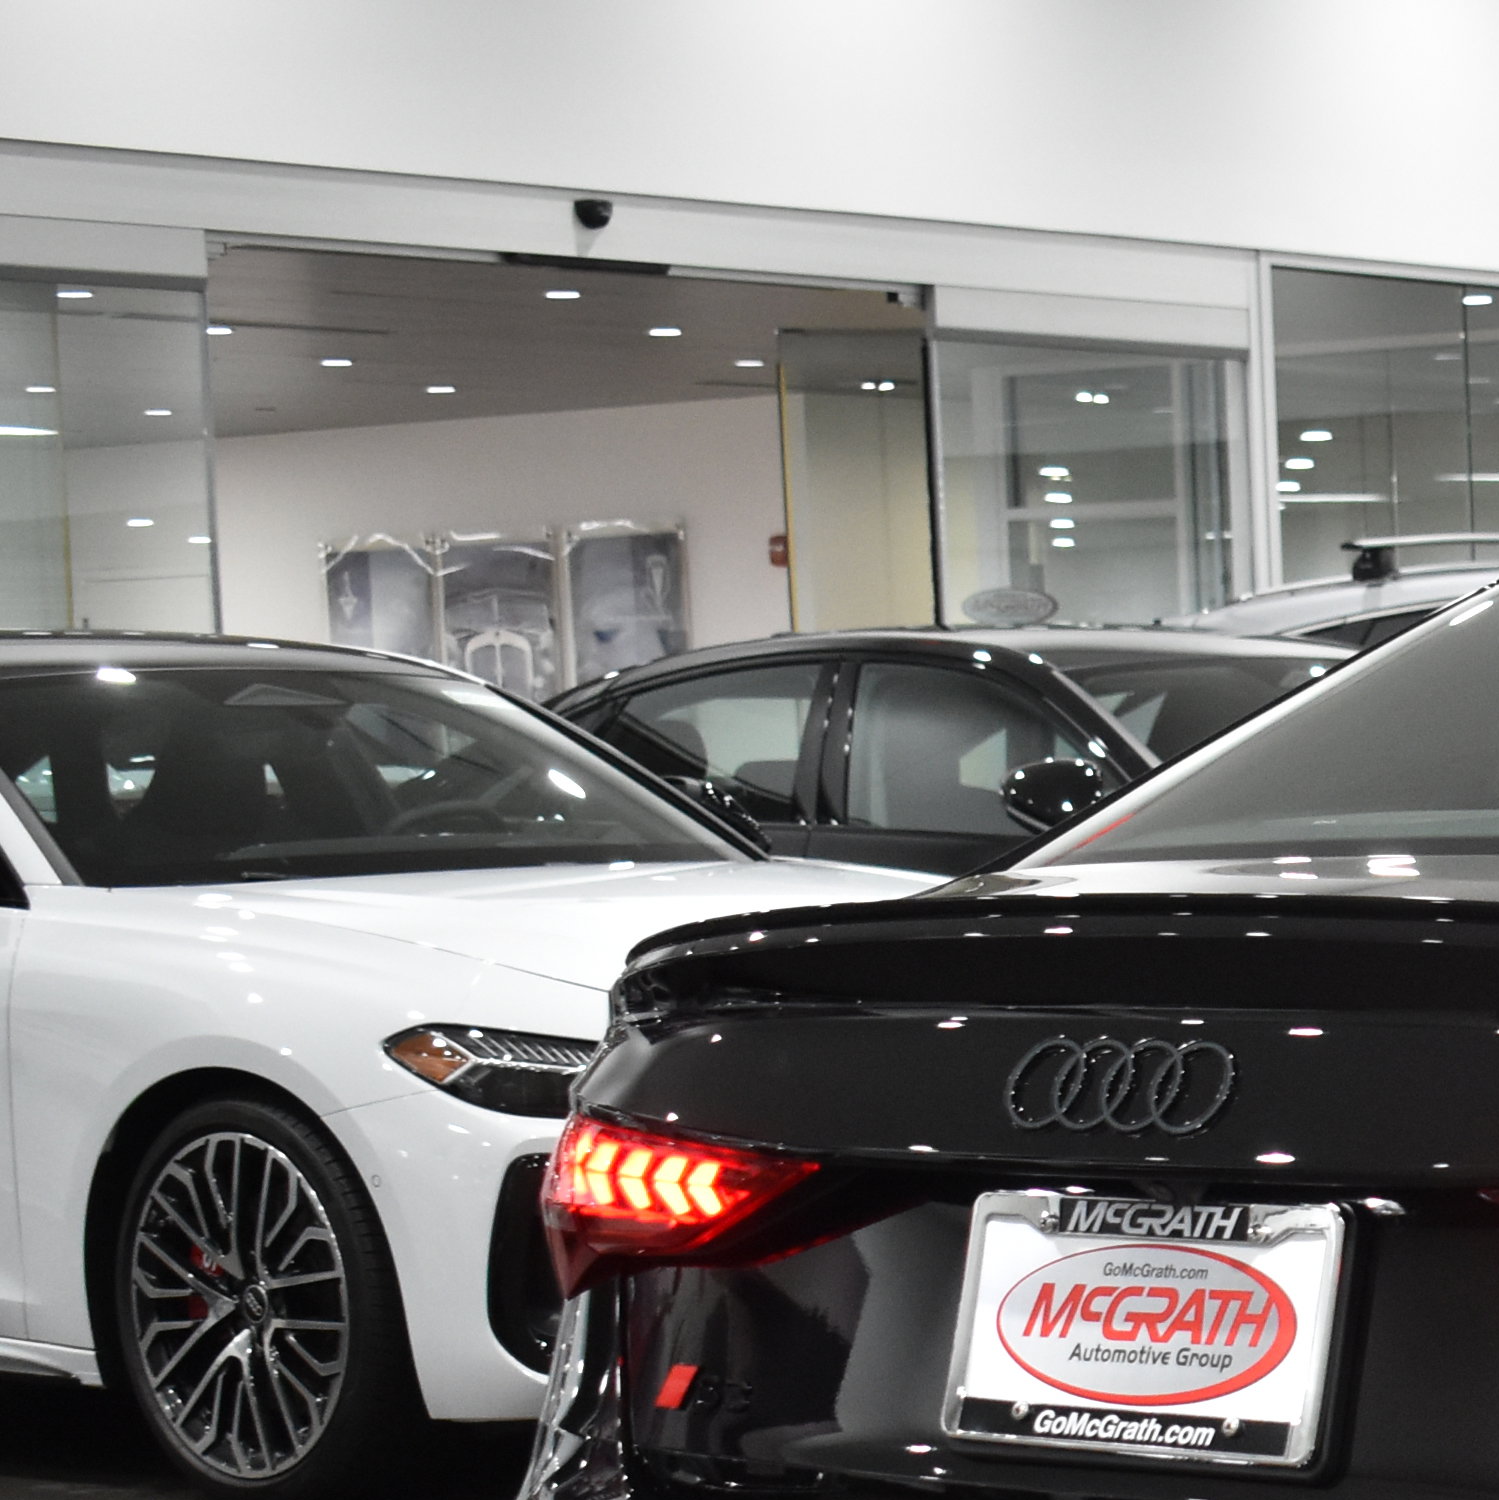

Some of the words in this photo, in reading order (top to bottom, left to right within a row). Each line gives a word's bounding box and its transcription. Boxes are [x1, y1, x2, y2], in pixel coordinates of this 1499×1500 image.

[1103, 1261, 1209, 1281] GoMcGrath.com
[1068, 1343, 1171, 1366] Automotive
[1175, 1347, 1234, 1374] Group
[1033, 1409, 1216, 1447] GoMcGrath.com
